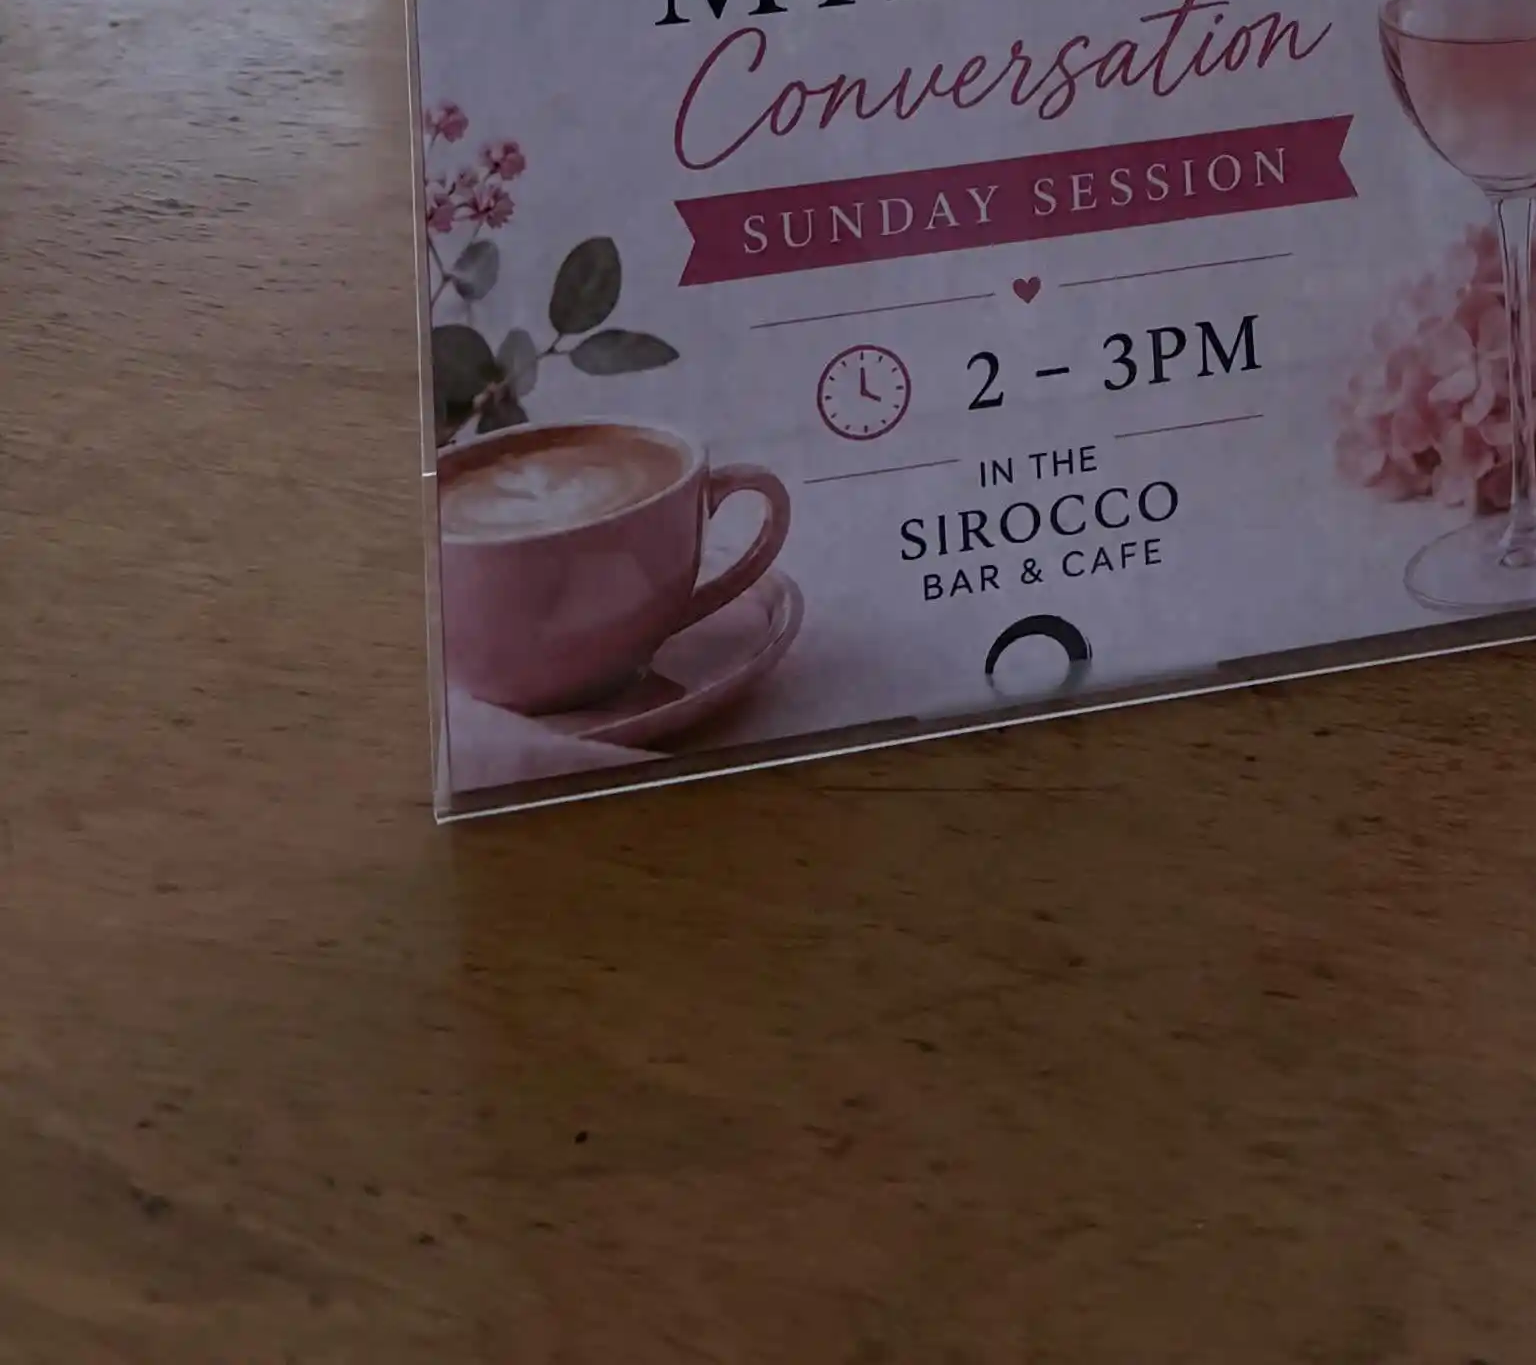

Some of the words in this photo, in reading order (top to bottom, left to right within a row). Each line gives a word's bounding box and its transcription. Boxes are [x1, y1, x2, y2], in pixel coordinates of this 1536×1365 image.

[743, 185, 1000, 255] SUNDAY
[1033, 147, 1288, 217] SESSION
[966, 351, 1005, 410] 2
[1103, 314, 1262, 391] 3PM
[979, 455, 1014, 487] IN
[1029, 445, 1099, 479] THE
[900, 480, 1179, 561] SIROCCO
[923, 563, 1000, 601] BAR
[1020, 557, 1044, 584] &
[1062, 538, 1163, 578] CAFE
